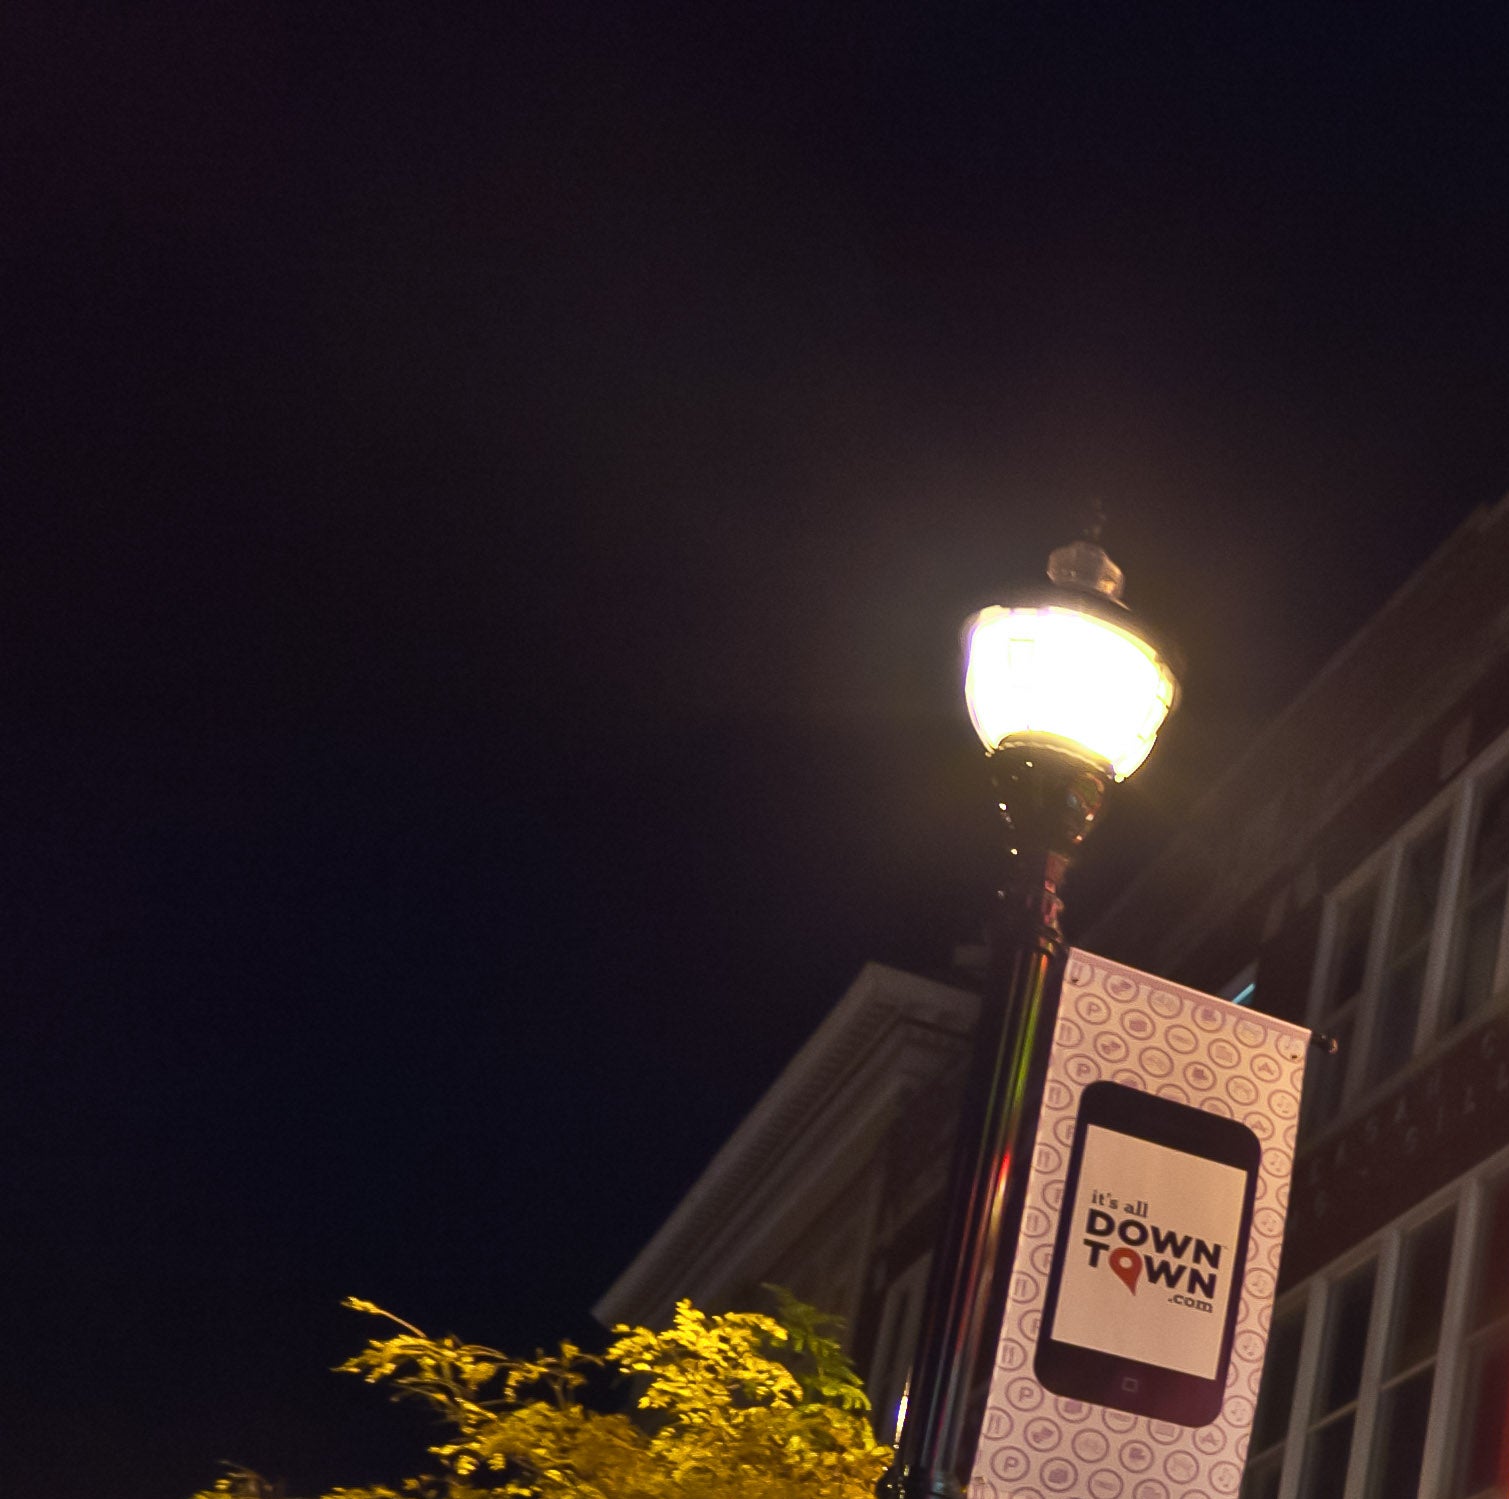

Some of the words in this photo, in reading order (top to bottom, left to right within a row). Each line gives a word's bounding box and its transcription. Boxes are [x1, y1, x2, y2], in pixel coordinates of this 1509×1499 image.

[1092, 1189, 1118, 1209] it's
[1124, 1200, 1148, 1218] all
[1085, 1208, 1221, 1269] DOWN
[1168, 1294, 1213, 1313] .com
